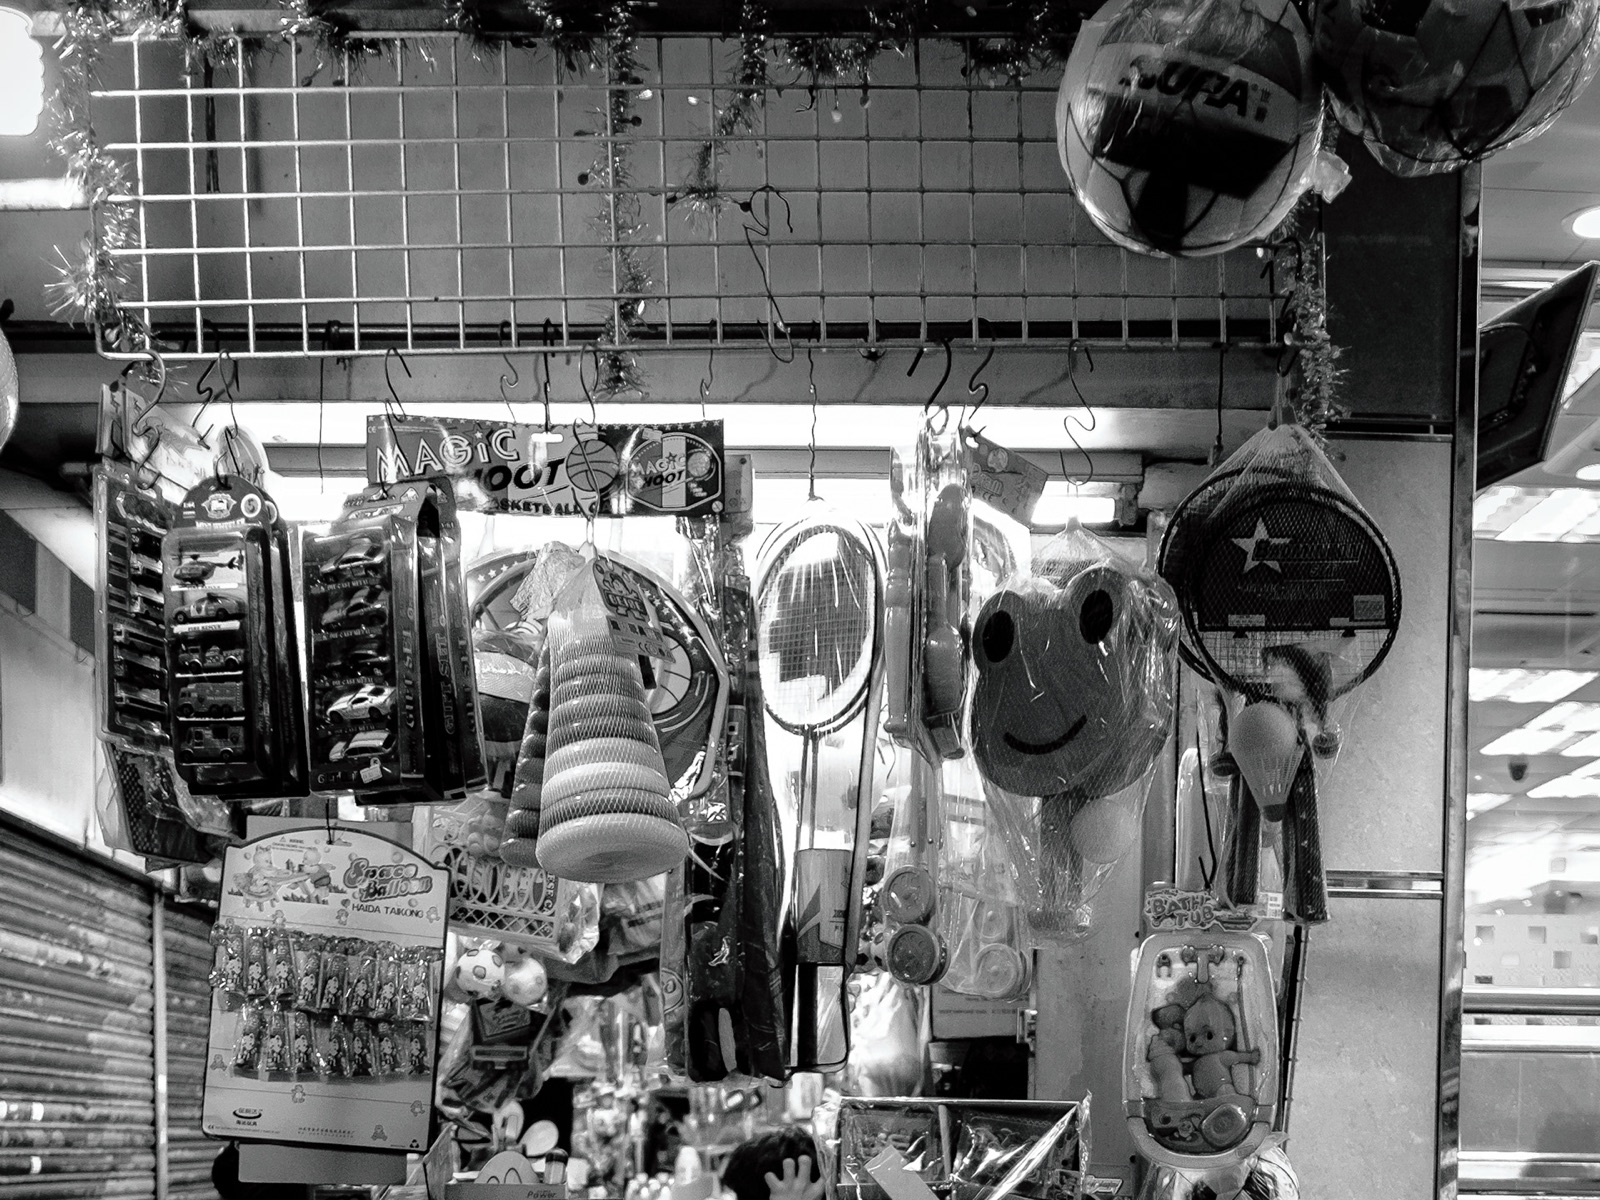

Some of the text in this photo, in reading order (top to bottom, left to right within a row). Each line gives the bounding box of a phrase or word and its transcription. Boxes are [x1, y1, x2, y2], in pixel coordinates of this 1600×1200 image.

[352, 903, 424, 919] HAIDA TAIKONG
[1175, 904, 1215, 928] TUB
